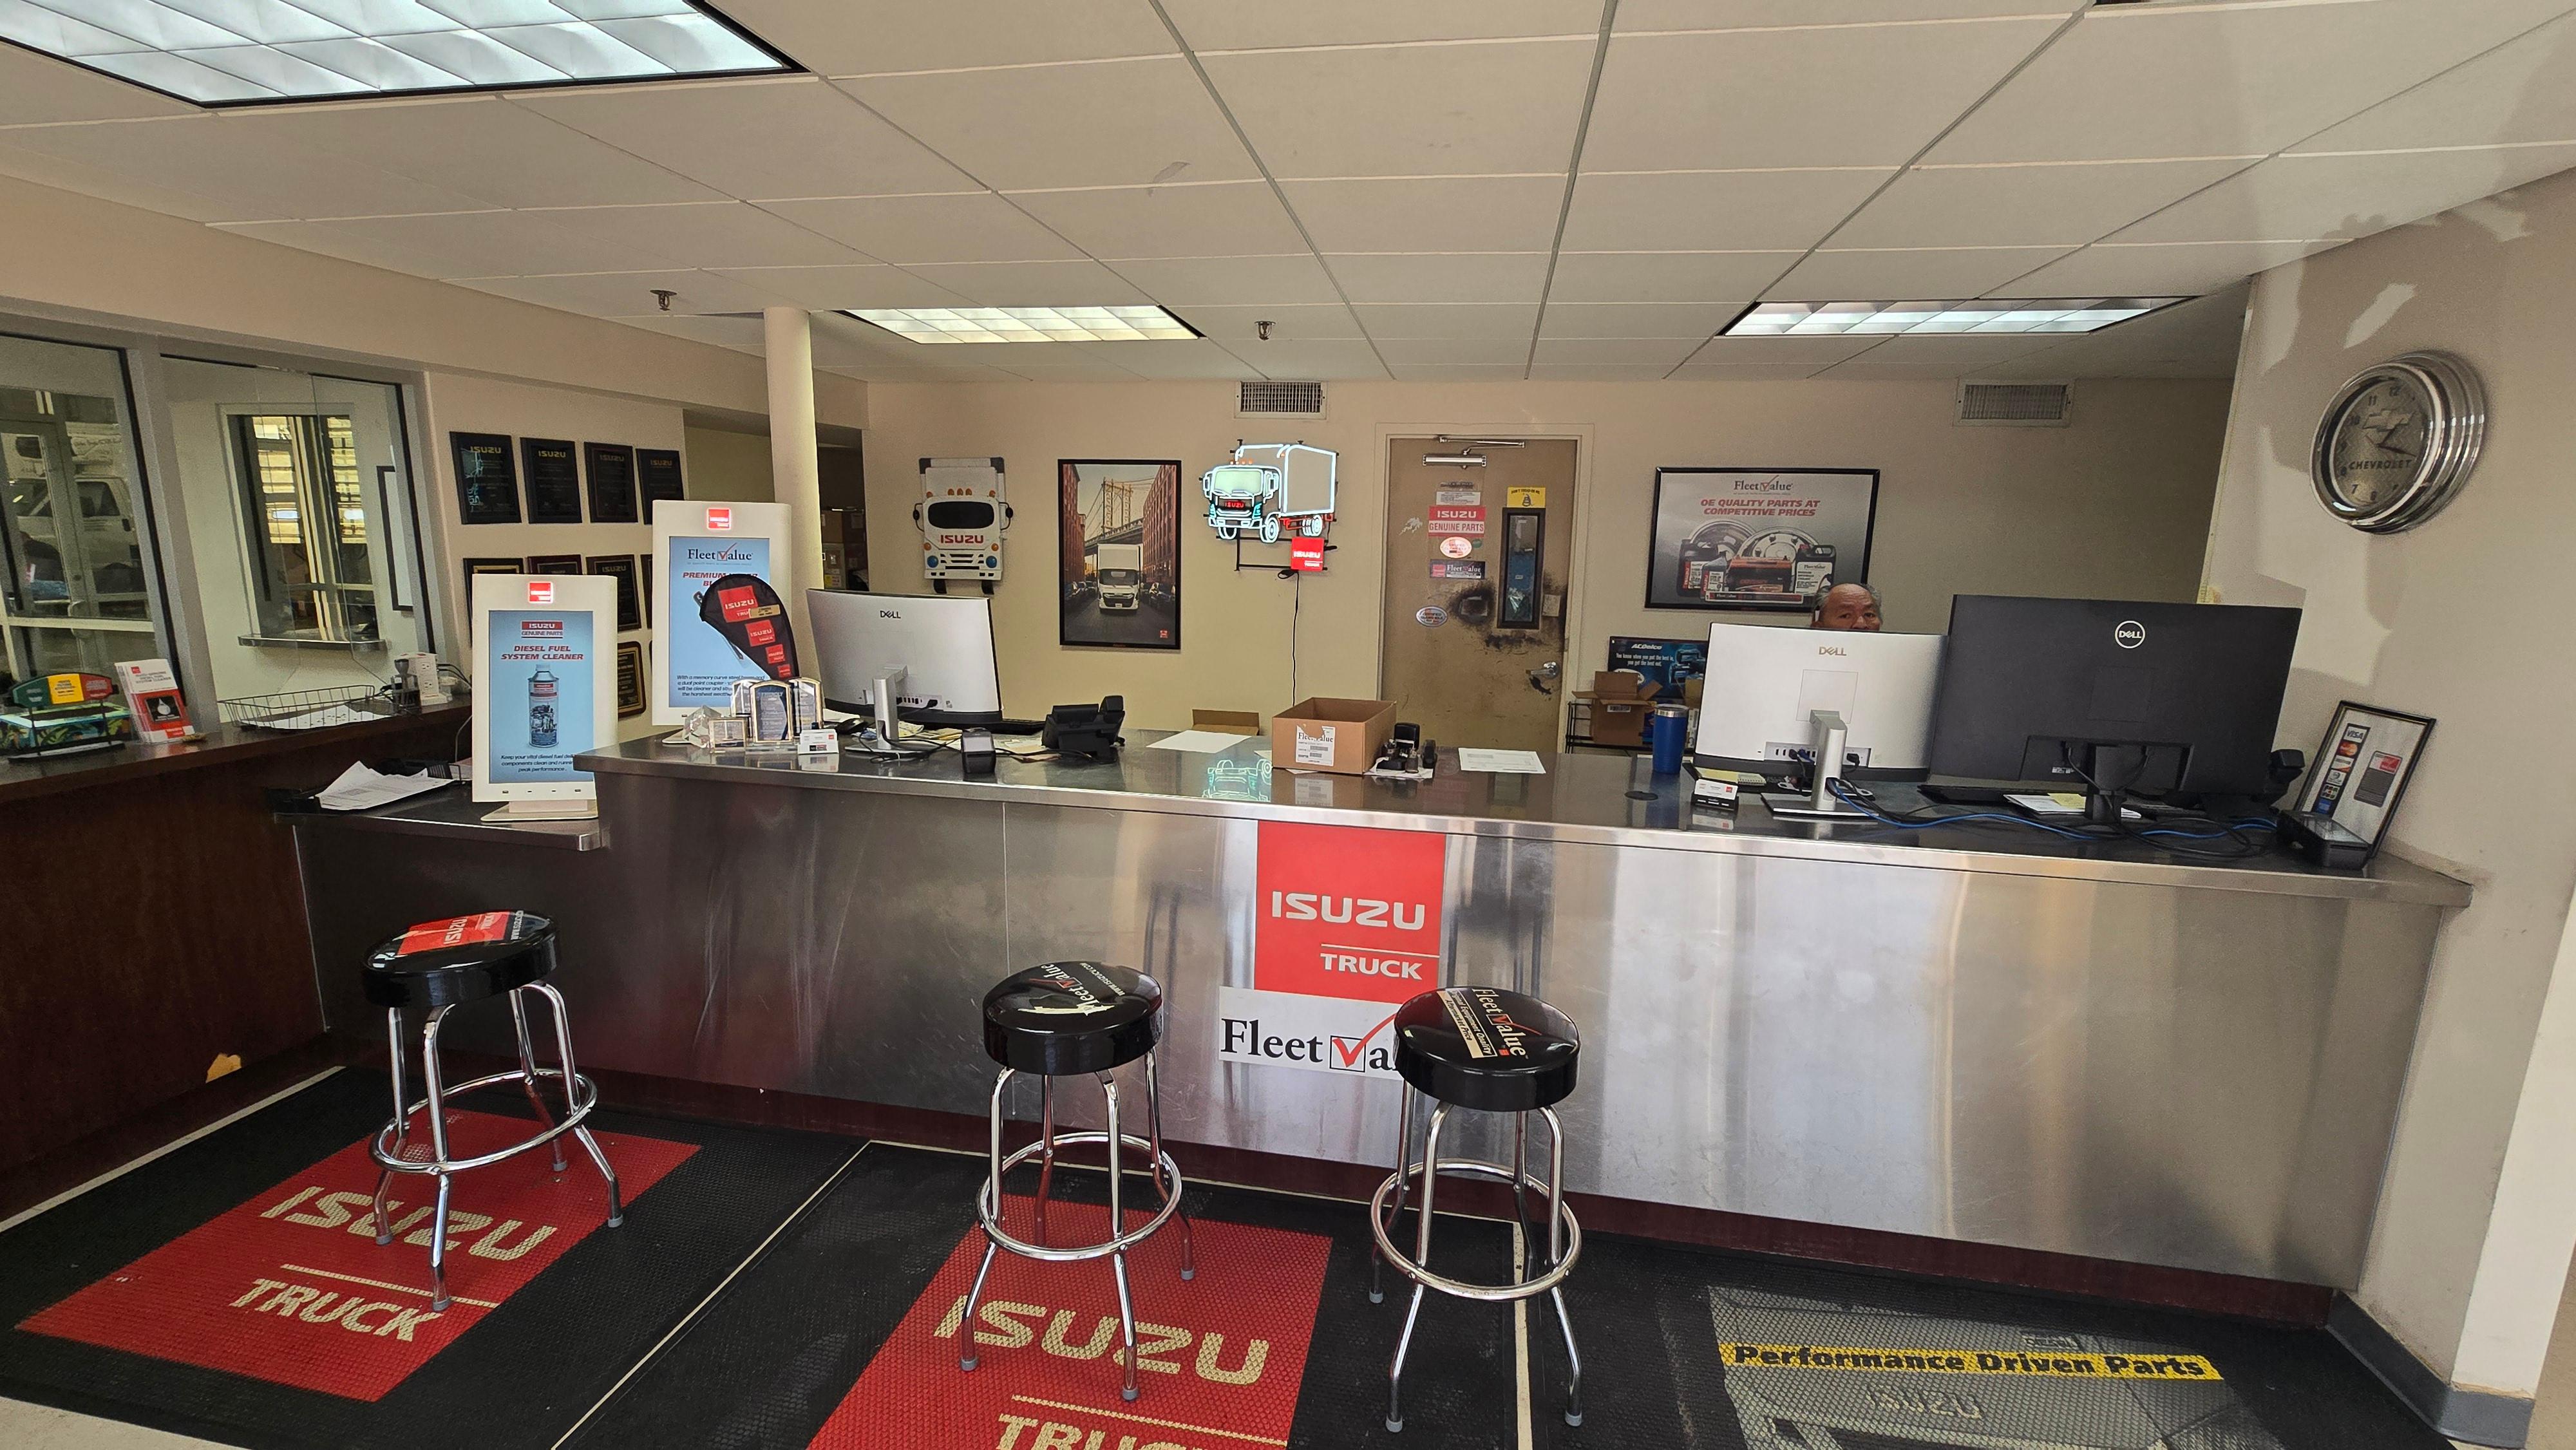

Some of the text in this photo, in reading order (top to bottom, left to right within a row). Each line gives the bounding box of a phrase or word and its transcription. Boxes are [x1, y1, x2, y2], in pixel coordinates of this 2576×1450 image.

[2350, 459, 2412, 470] CHEVROLET
[2351, 484, 2358, 494] 7
[1429, 523, 1484, 532] GENUINE PARTS
[940, 535, 984, 543] ISUZU
[724, 599, 755, 610] ISUZU
[880, 610, 901, 619] DELL
[750, 628, 772, 637] ISUZU
[2118, 630, 2142, 639] DELL
[1819, 646, 1847, 656] DELL
[2347, 730, 2364, 740] VISA
[1272, 890, 1425, 931] ISUZU
[444, 918, 468, 945] ISUZU
[1320, 952, 1423, 980] TRUCK
[1460, 1026, 1473, 1041] Price
[260, 1185, 558, 1261] ISUZU
[229, 1277, 444, 1342] TRUCK
[933, 1295, 1270, 1386] ISUZU
[1734, 1346, 2205, 1377] Performance Driven Parts
[1866, 1384, 1982, 1418] ISUZU
